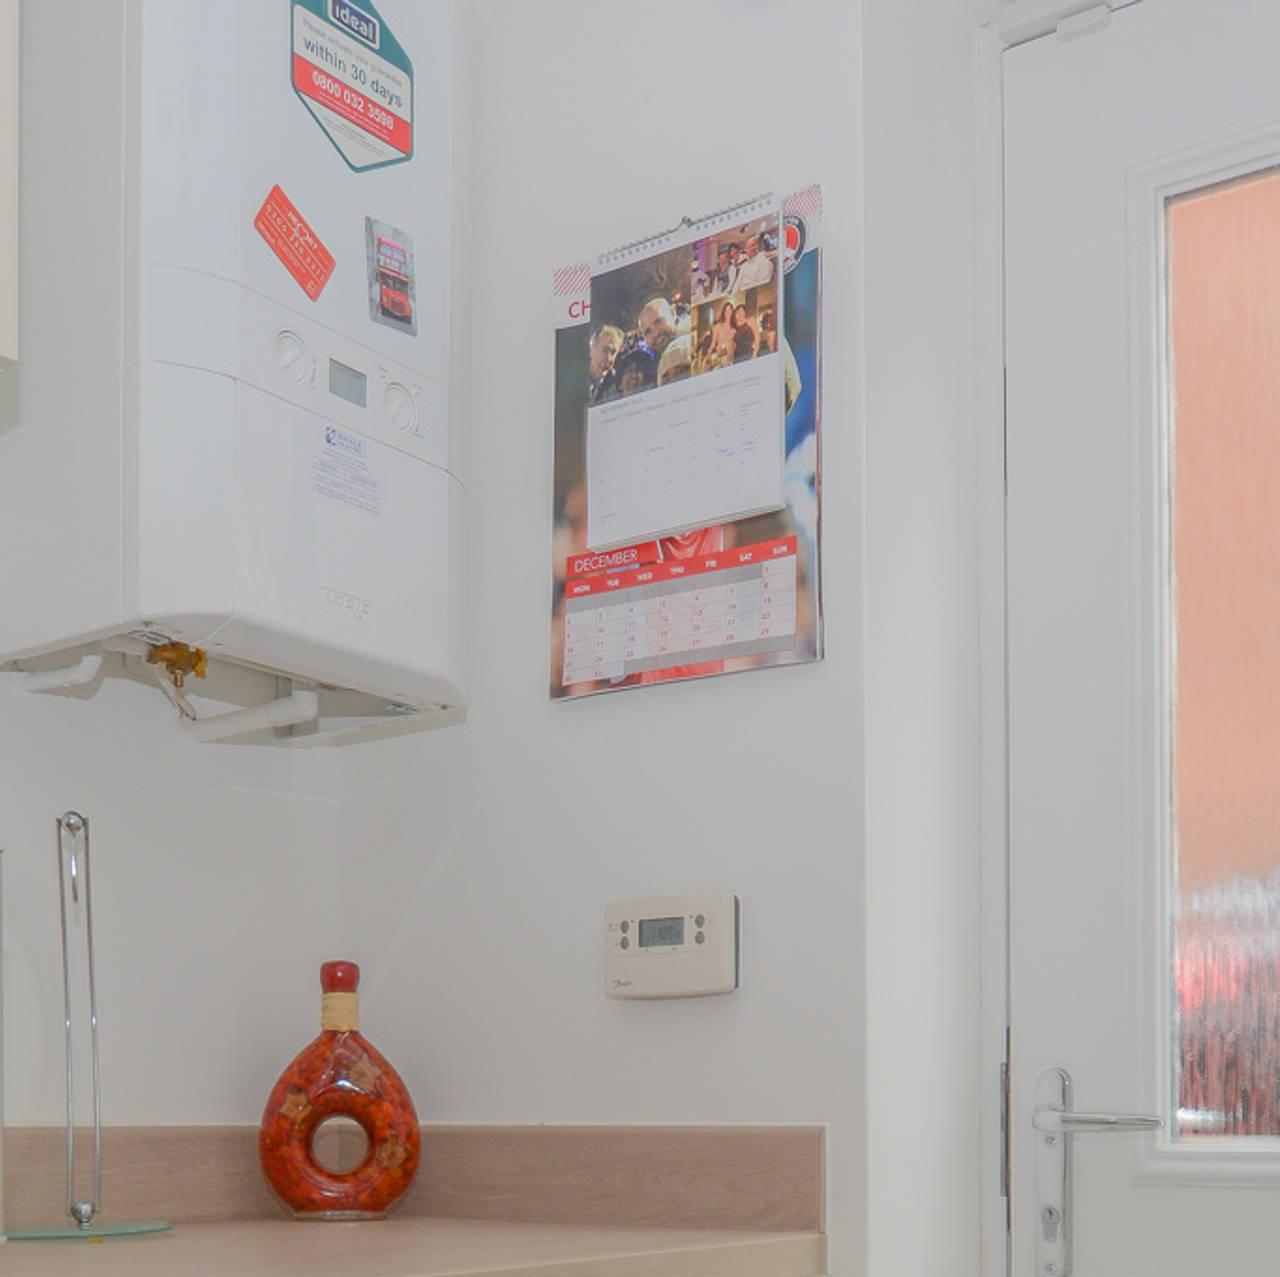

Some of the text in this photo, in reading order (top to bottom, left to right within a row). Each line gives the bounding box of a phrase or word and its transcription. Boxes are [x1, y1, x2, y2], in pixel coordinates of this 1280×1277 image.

[335, 3, 374, 41] ideal
[303, 38, 402, 108] within 30 days
[574, 549, 638, 573] DECEMBER
